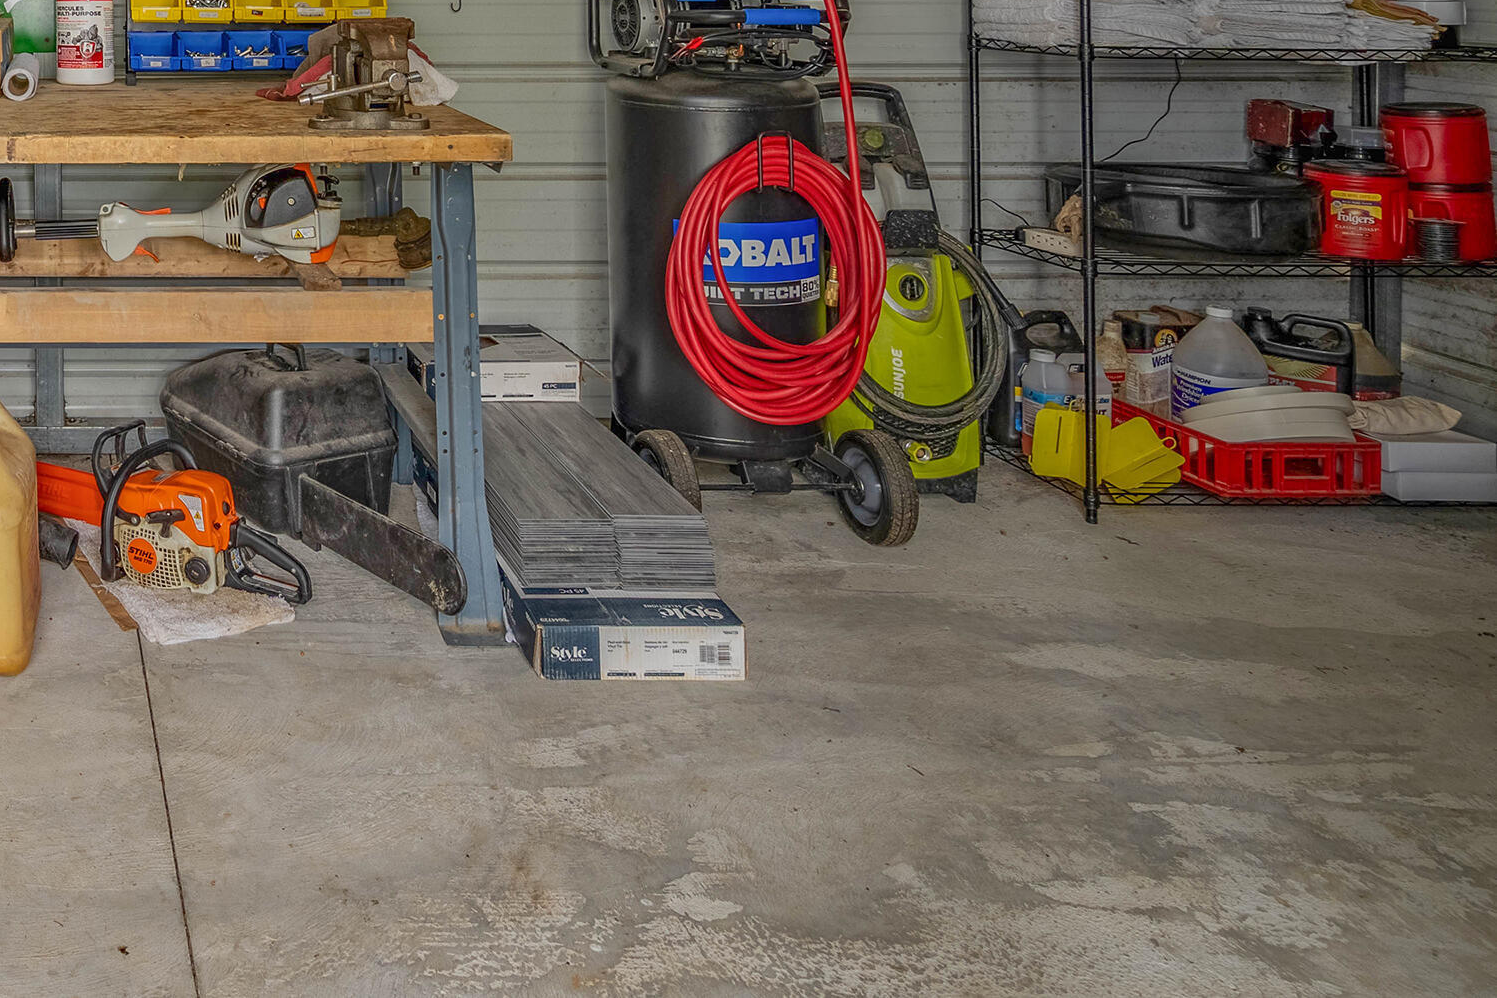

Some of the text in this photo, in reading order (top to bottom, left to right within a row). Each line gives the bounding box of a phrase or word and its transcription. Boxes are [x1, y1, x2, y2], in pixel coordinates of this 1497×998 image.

[1337, 211, 1375, 225] Folgers
[749, 285, 801, 300] TECH
[802, 280, 819, 293] 80%
[1152, 354, 1173, 368] Wate
[128, 546, 154, 561] STIHL
[551, 646, 587, 662] Style
